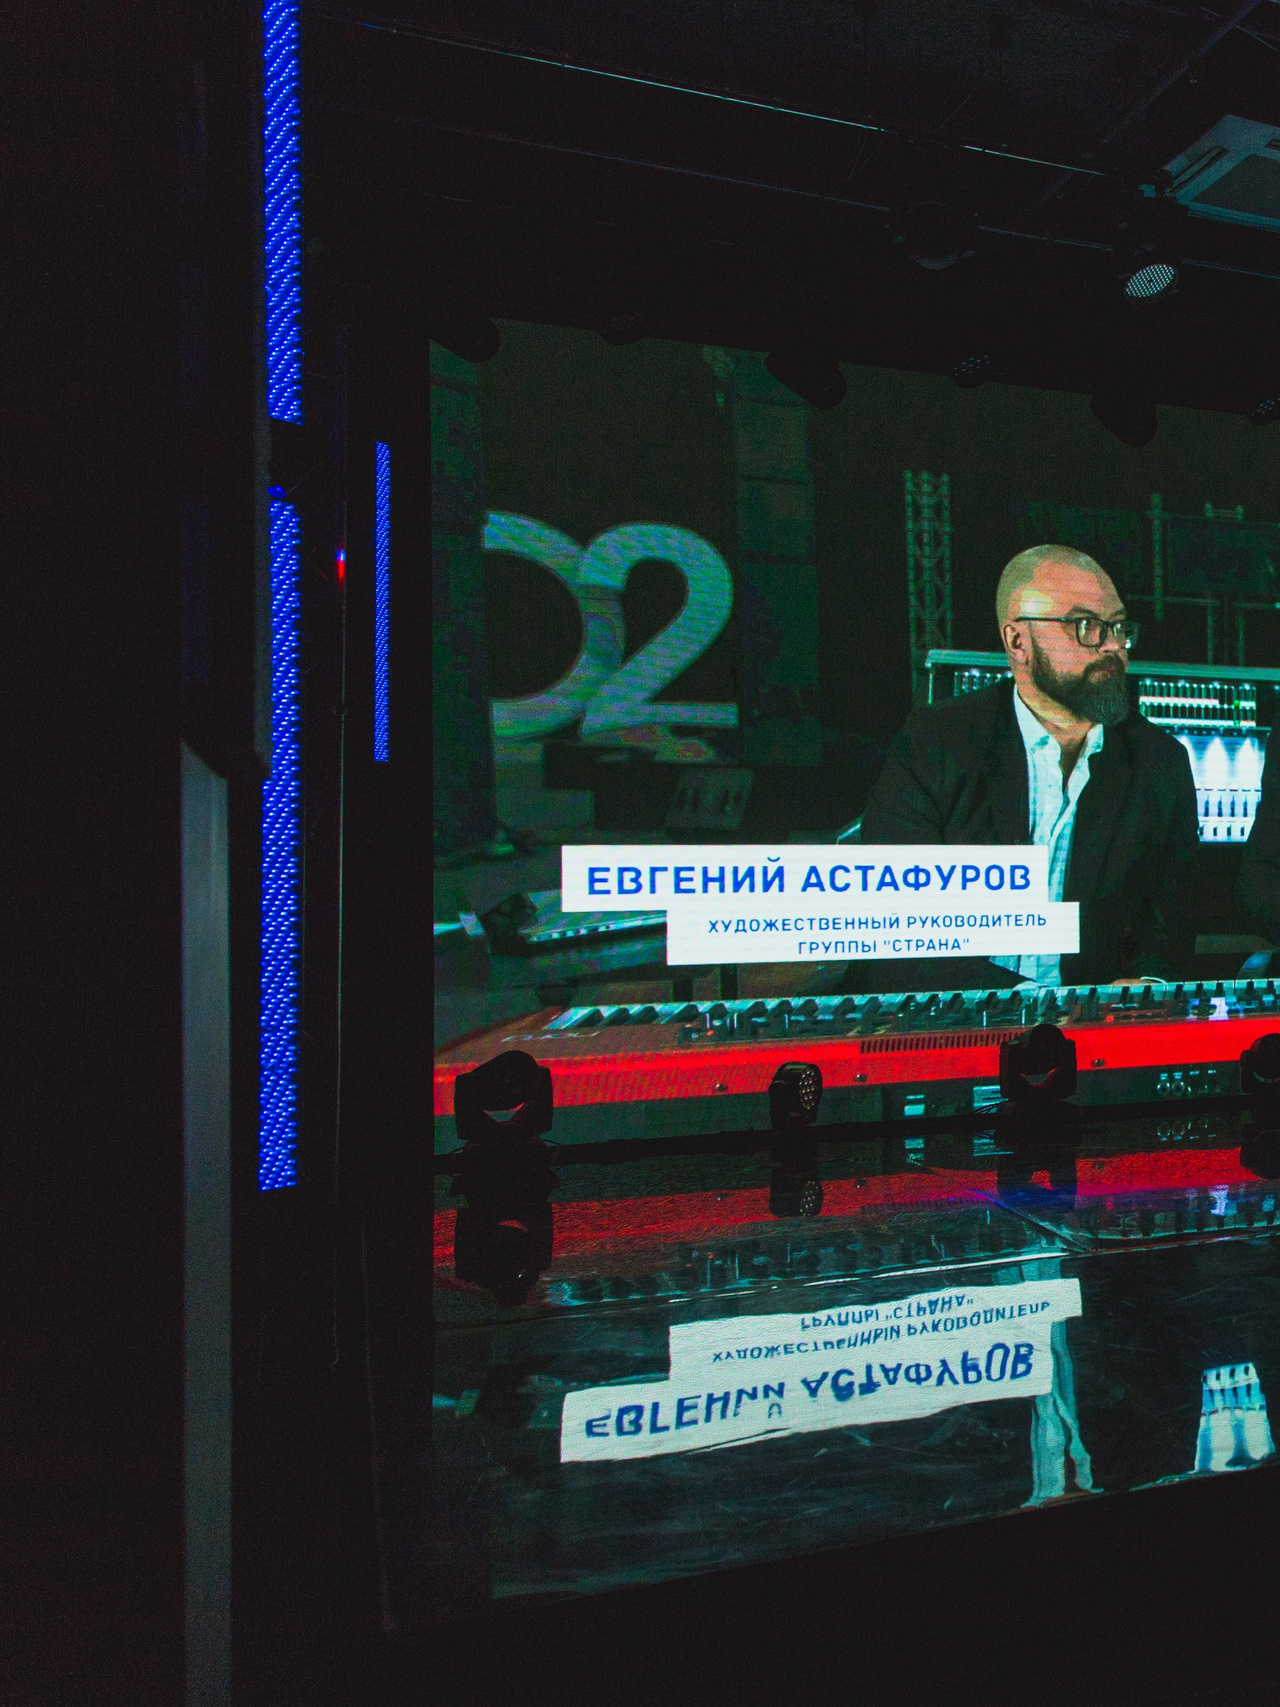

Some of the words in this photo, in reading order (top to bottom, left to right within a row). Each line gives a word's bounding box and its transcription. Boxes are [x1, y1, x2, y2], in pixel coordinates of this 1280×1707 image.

[587, 857, 785, 896] ЕВГЕНИЙ
[800, 863, 1031, 893] АСТАФУРОВ
[708, 914, 900, 934] ХУДОЖЕСТВЕННЫЙ
[906, 913, 1047, 931] РУКОВОДИТЕЛЬ
[797, 940, 877, 955] ГРУППЫ
[883, 938, 971, 953] "СТРАНА"
